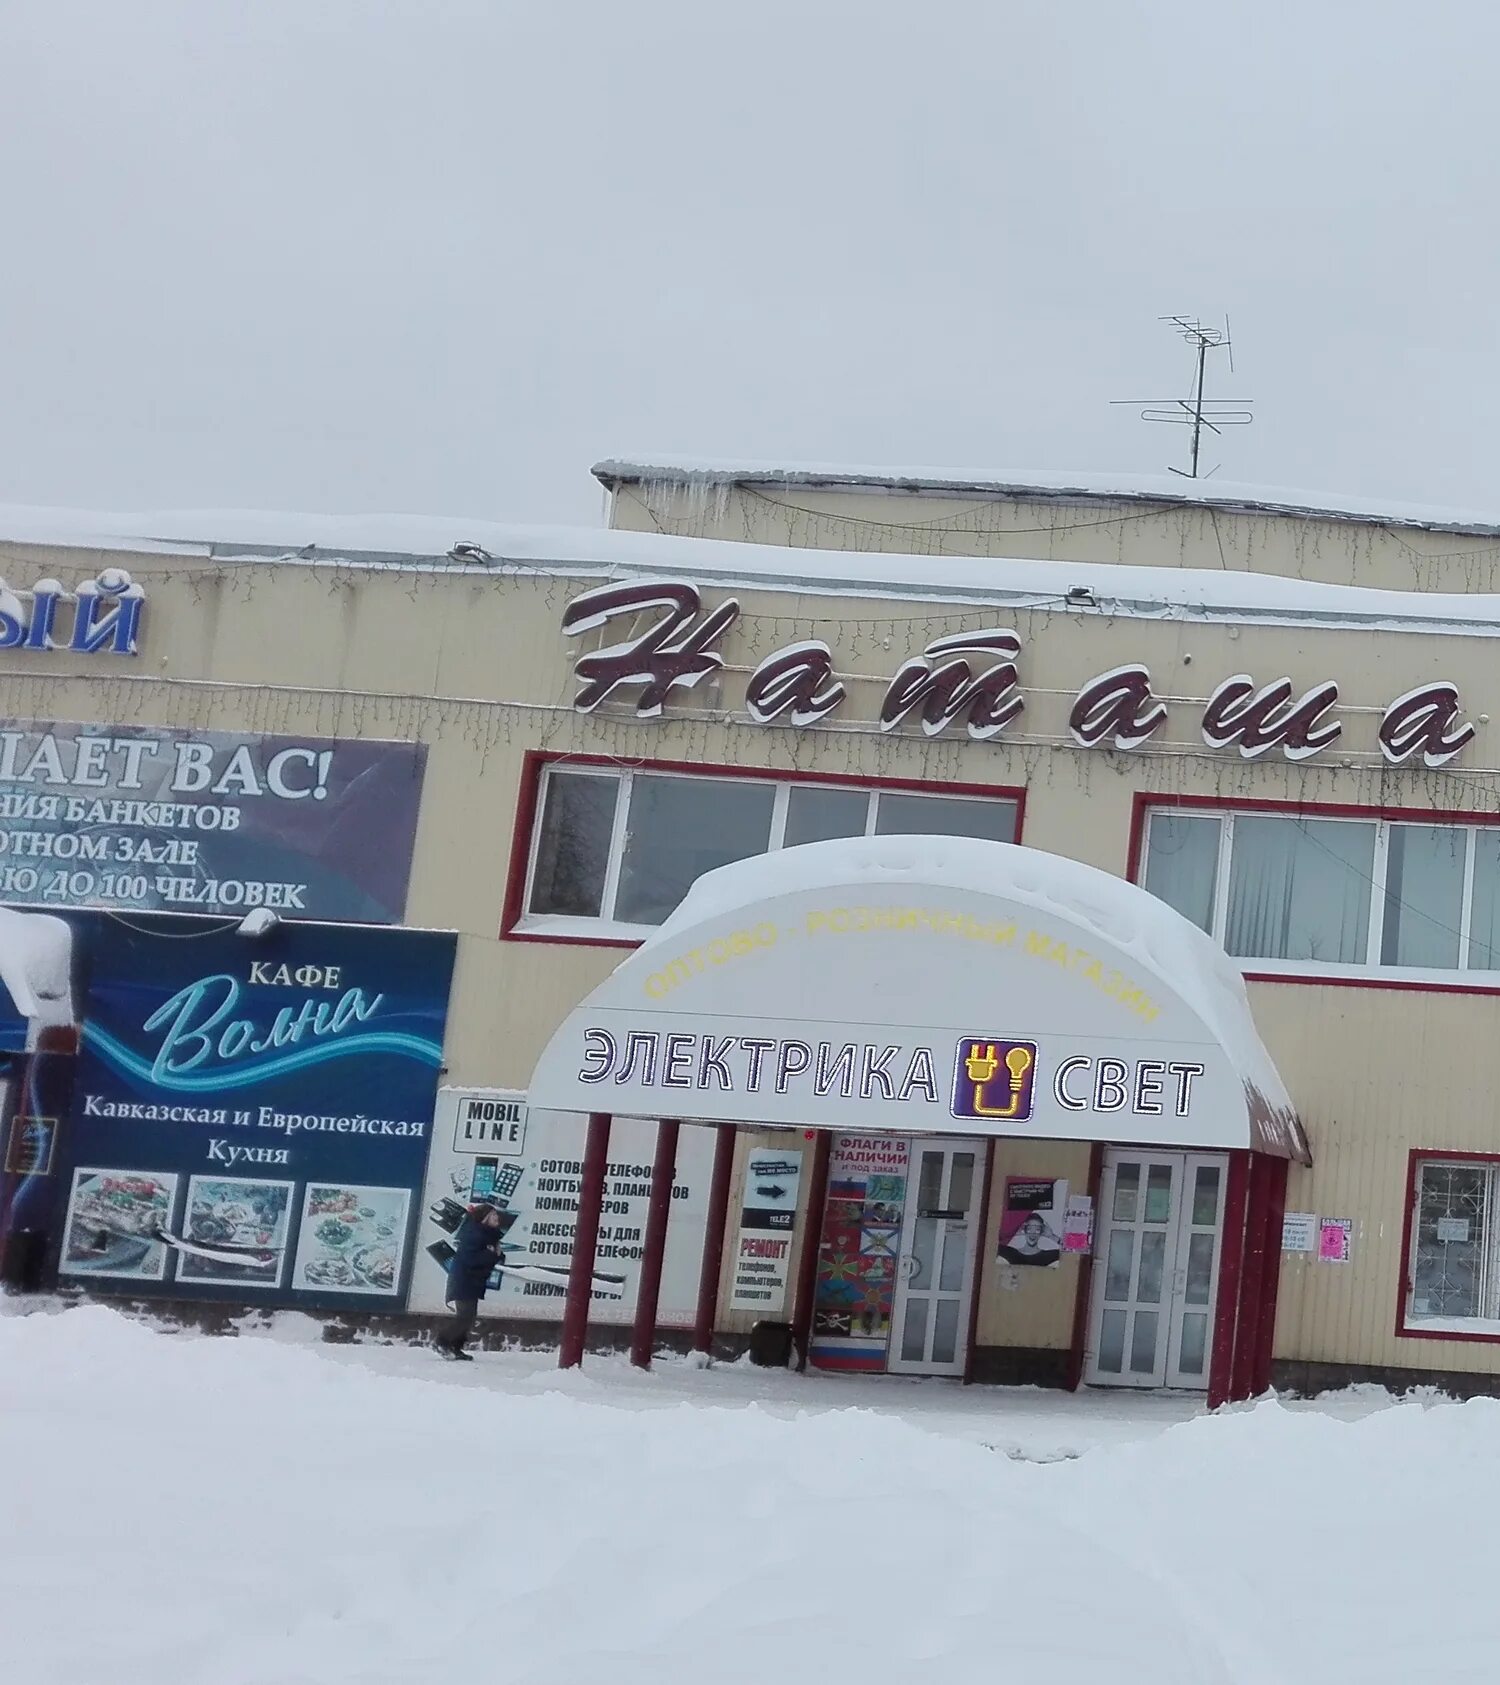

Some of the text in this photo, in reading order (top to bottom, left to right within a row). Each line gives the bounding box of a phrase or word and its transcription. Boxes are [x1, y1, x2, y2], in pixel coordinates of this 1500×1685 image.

[562, 578, 1475, 767] Наташа
[171, 741, 334, 800] ВАС!
[63, 797, 241, 831] БАНКЕТОВ
[115, 837, 199, 865] ЗАЛЕ
[43, 870, 94, 899] ДО
[101, 874, 148, 900] 100
[155, 876, 307, 909] ЧЕЛОВЕК
[248, 962, 341, 989] КАФЕ
[143, 974, 384, 1083] Волна
[578, 1026, 1205, 1117] ЭЛЕКТРИКА СВЕТ
[85, 1095, 424, 1137] Кавказская и Европейская
[468, 1102, 520, 1122] MOBIL
[207, 1140, 289, 1167] Кухня
[835, 1150, 908, 1164] НАЛИЧИИ
[840, 1138, 906, 1151] ФЛАГИ В
[535, 1197, 629, 1214] КОМПЬЕРОВ
[769, 1215, 790, 1223] TELE2
[613, 1227, 641, 1241] ДЛЯ
[740, 1238, 789, 1259] РЕМОНТ
